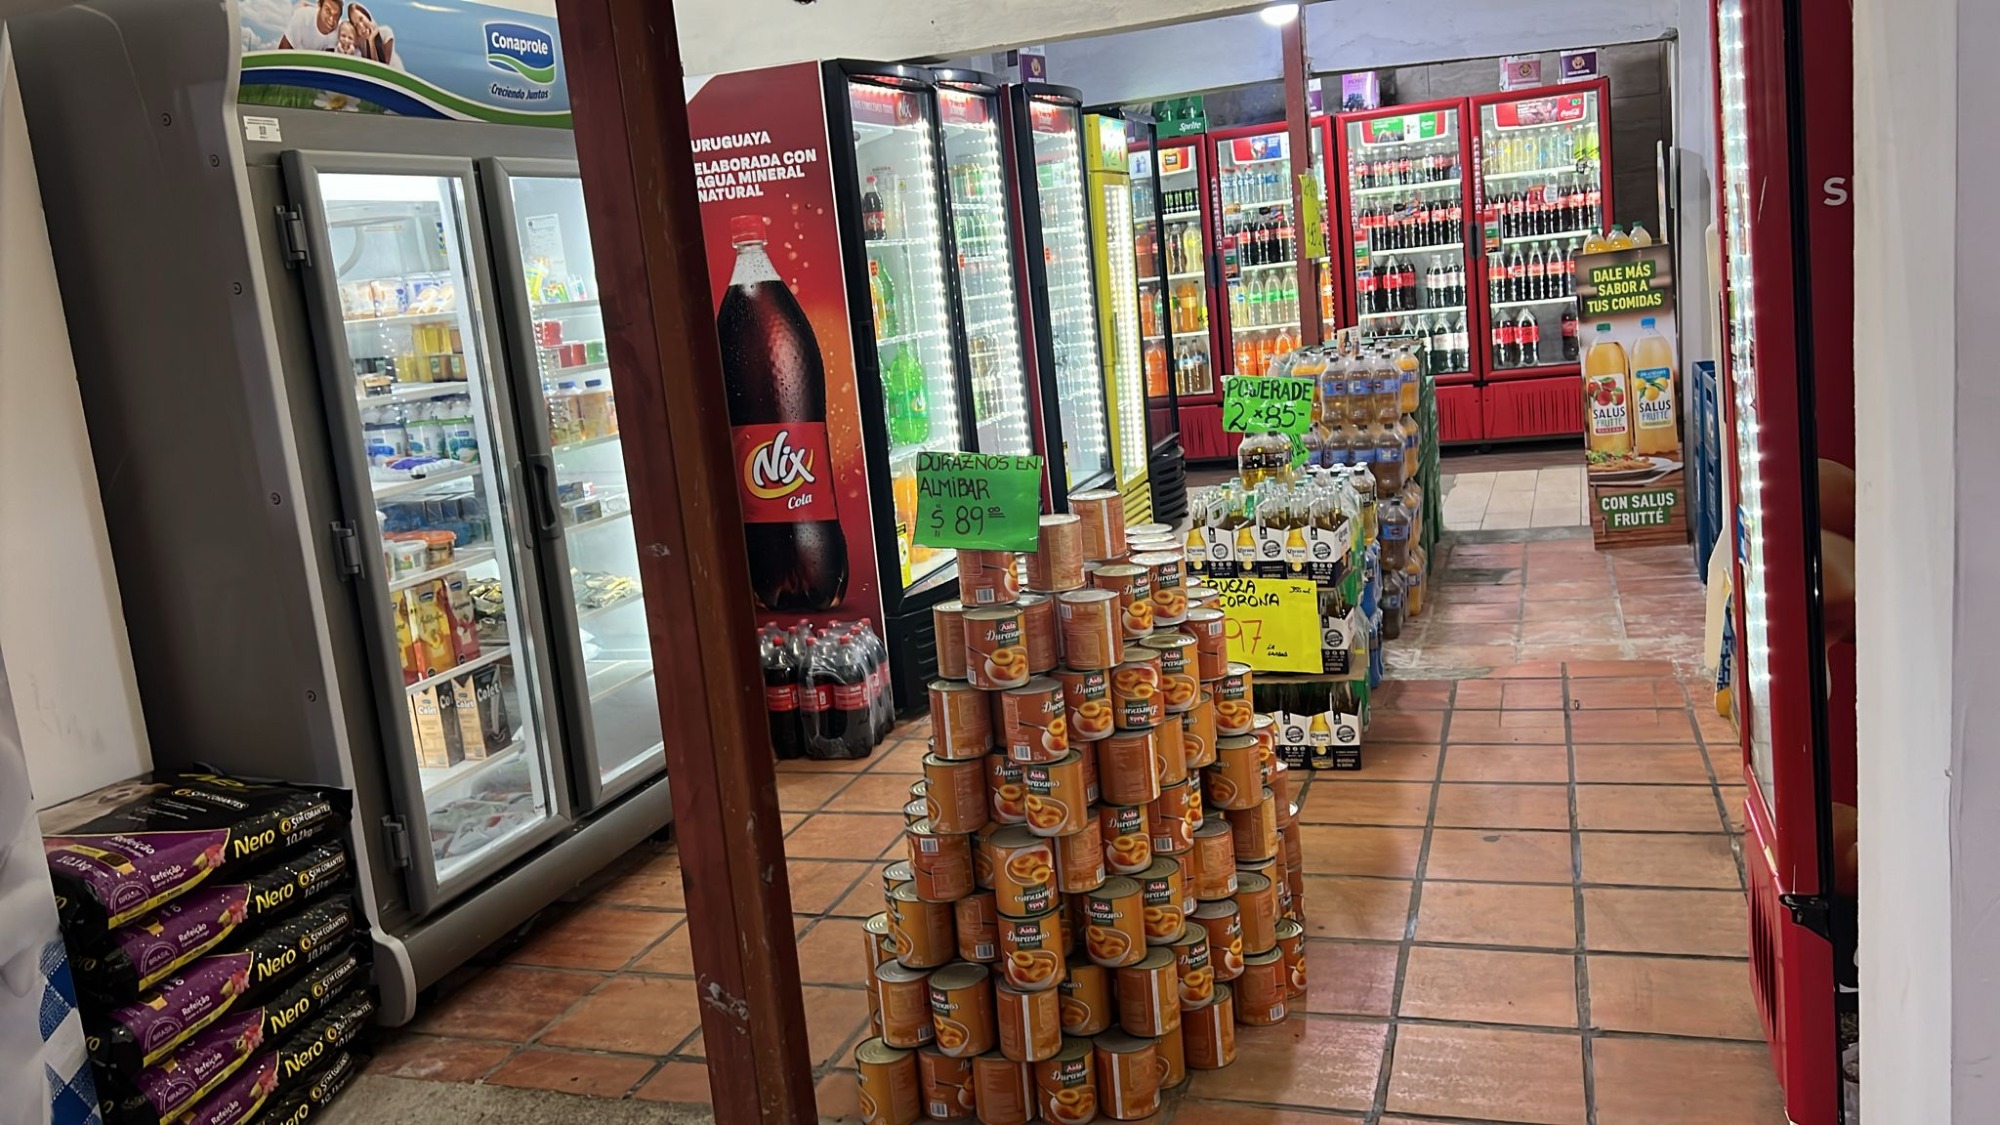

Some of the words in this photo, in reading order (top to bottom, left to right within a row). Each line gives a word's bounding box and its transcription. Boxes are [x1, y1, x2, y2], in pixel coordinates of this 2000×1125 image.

[491, 31, 548, 55] Conaprole
[491, 83, 525, 100] Creciendo
[1179, 121, 1201, 133] Sprite
[691, 131, 771, 153] URUGUAYA
[694, 152, 781, 176] ELABORADA
[782, 148, 817, 165] CON
[696, 173, 737, 189] AGUA
[737, 164, 805, 185] MINERAL
[698, 183, 764, 203] NATURAL
[1593, 267, 1623, 283] DALE
[1625, 262, 1651, 279] MÁS
[1598, 282, 1637, 297] SABOR
[1639, 282, 1648, 291] A
[1587, 301, 1609, 313] TUS
[1611, 293, 1662, 310] COMIDAS
[1593, 406, 1626, 420] SALUS
[1639, 399, 1671, 413] SALUS
[1228, 402, 1247, 431] 2
[752, 430, 815, 486] Nix
[917, 452, 1009, 472] DURAZNOS
[1015, 456, 1038, 471] EN
[788, 493, 813, 510] Cola
[1602, 497, 1628, 511] CON
[1632, 492, 1675, 508] SALUS
[1614, 508, 1664, 527] FRUTTÉ
[1220, 593, 1280, 608] CORONA
[1224, 618, 1262, 655] 97
[1160, 658, 1191, 668] uraznos
[439, 696, 454, 709] Col
[477, 683, 501, 702] Colet
[234, 829, 275, 859] Nero
[150, 864, 182, 883] Refeição
[255, 883, 294, 913] Nero
[178, 923, 207, 943] Refeição
[257, 949, 297, 982] Nero
[181, 995, 211, 1016] Refeição
[270, 997, 310, 1034] Nero
[194, 1052, 223, 1076] Refeição
[284, 1040, 324, 1078] Nero
[210, 1100, 239, 1124] Refeição
